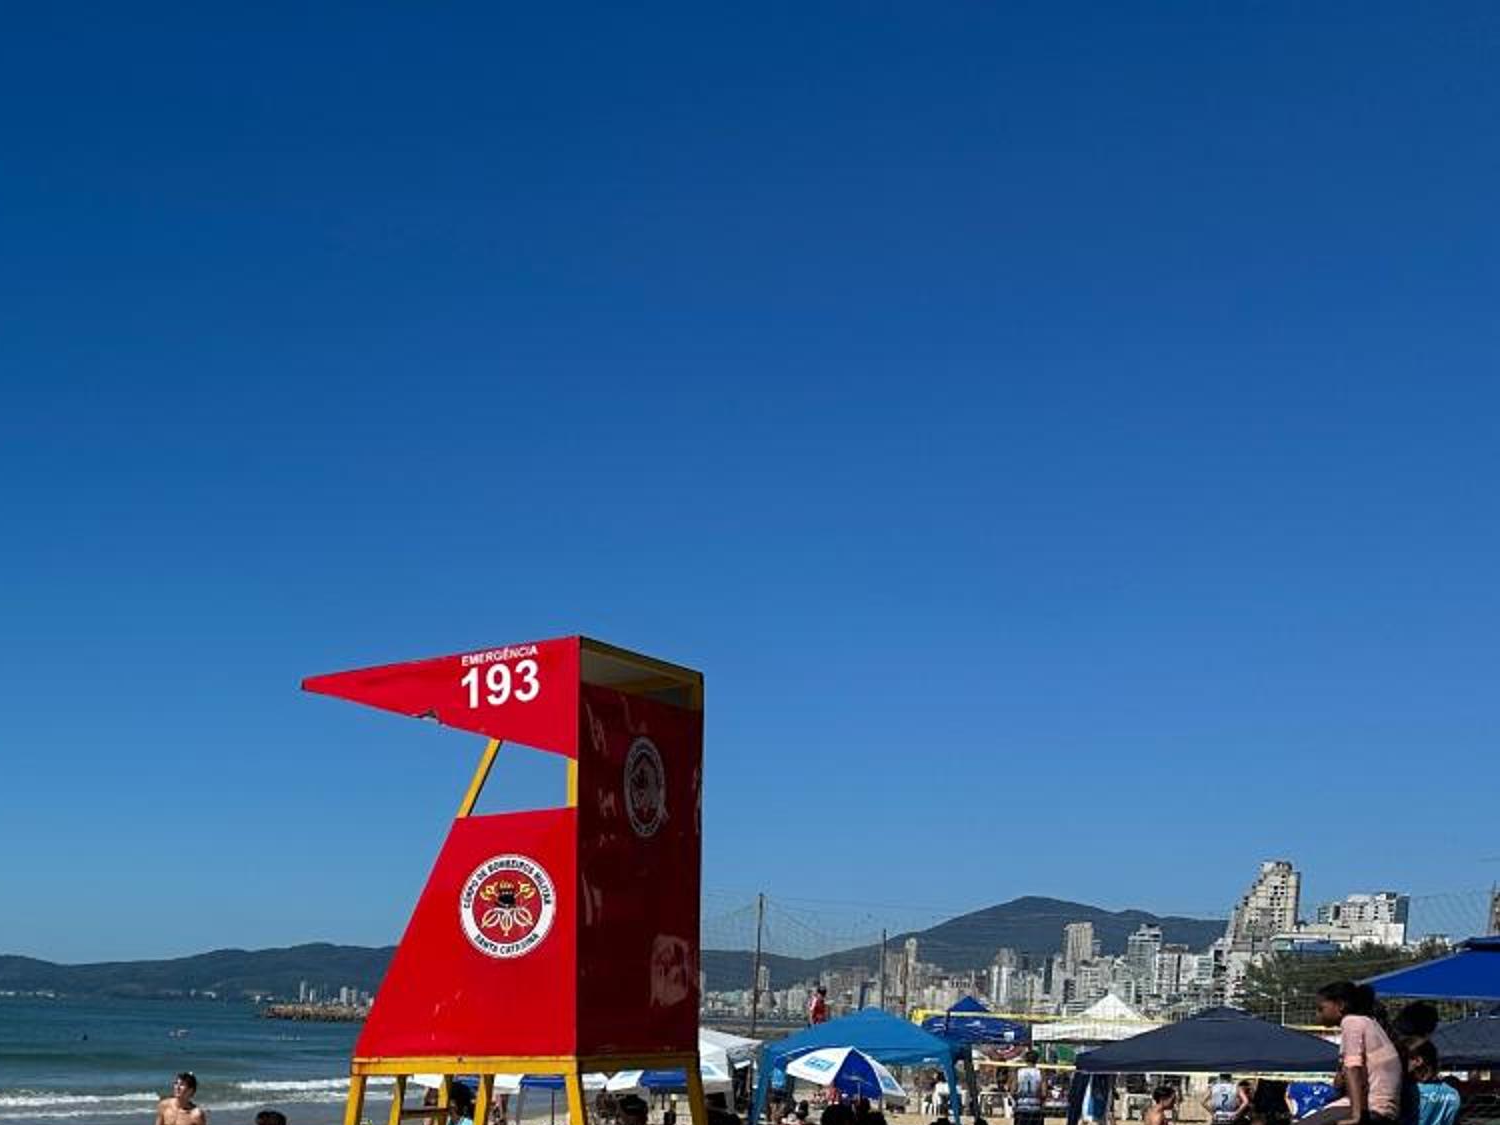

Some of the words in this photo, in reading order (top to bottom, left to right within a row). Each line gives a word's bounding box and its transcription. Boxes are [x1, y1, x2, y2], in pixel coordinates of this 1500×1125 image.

[461, 645, 538, 666] EMERGÊNCIA
[461, 659, 540, 709] 193
[487, 859, 535, 875] BOMBEIROS
[534, 871, 552, 905] MILITAR
[474, 934, 498, 952] SANTA
[500, 933, 540, 954] CATARINA
